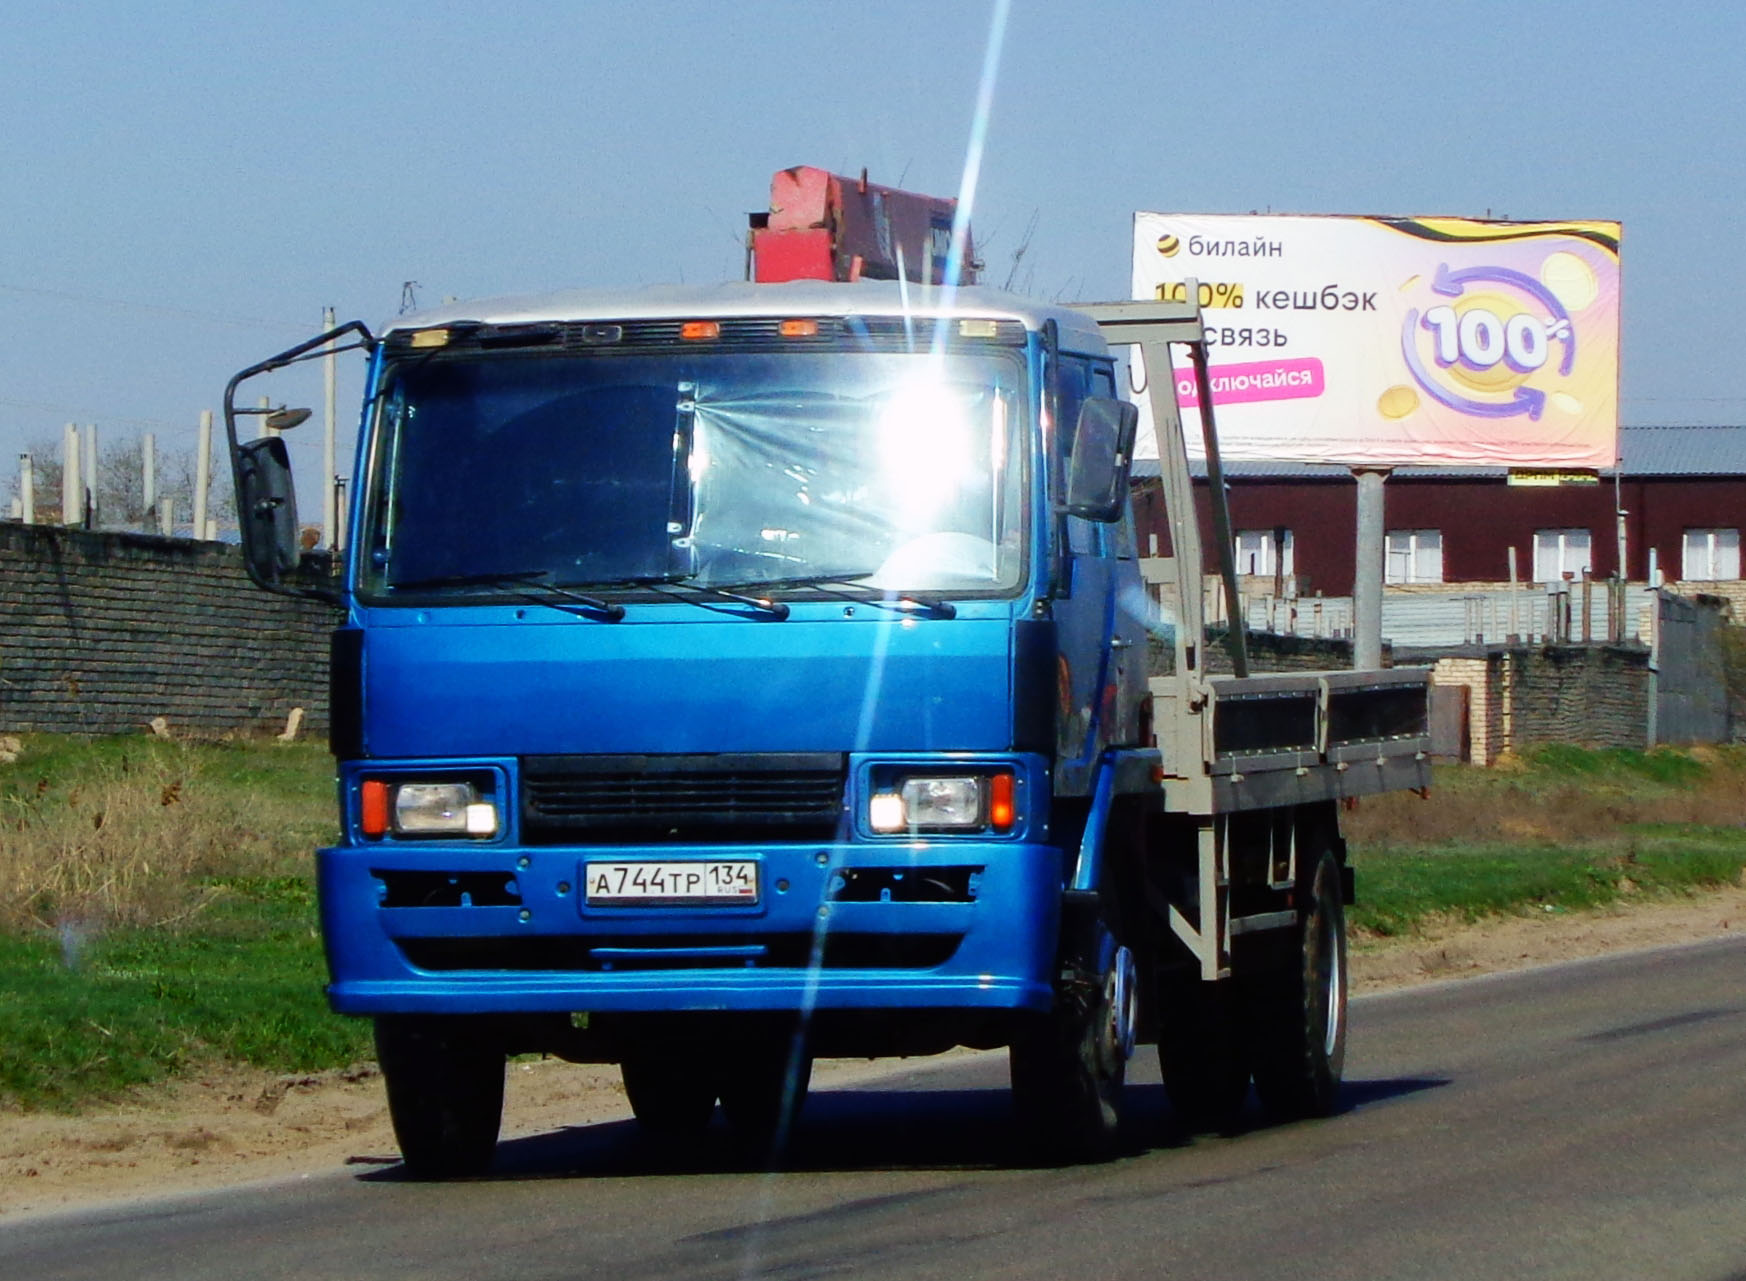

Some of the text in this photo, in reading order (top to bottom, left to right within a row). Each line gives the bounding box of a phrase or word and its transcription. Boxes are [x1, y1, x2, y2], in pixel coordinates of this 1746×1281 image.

[1188, 235, 1283, 257] билайн
[1255, 283, 1377, 311] кешбэк
[1202, 327, 1288, 347] связь
[1421, 305, 1570, 373] 100%
[708, 865, 748, 885] 134
[717, 886, 738, 894] RUS
